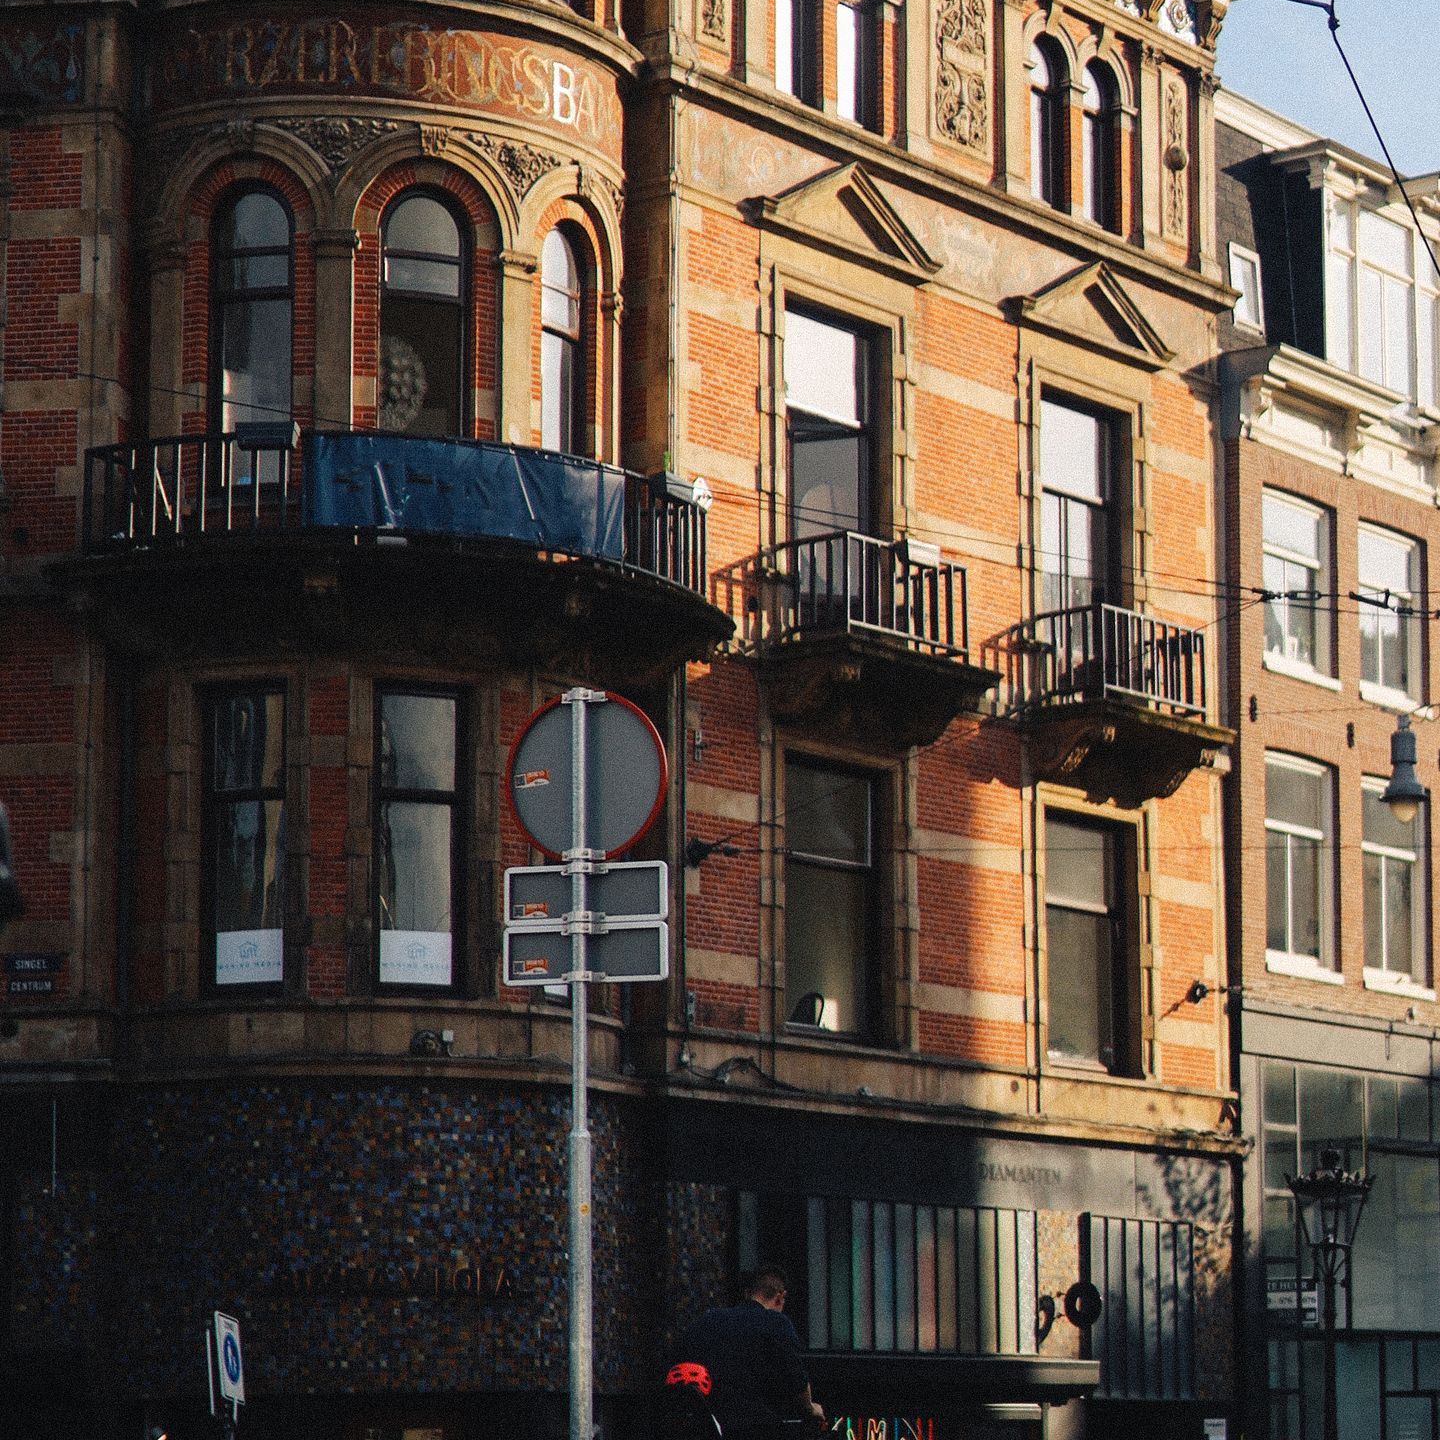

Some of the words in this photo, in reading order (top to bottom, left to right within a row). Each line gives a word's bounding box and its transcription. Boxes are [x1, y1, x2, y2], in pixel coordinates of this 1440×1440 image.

[15, 959, 48, 969] SINGEL
[10, 981, 52, 991] CENTRUM
[978, 1162, 1061, 1185] DIAMANTEN
